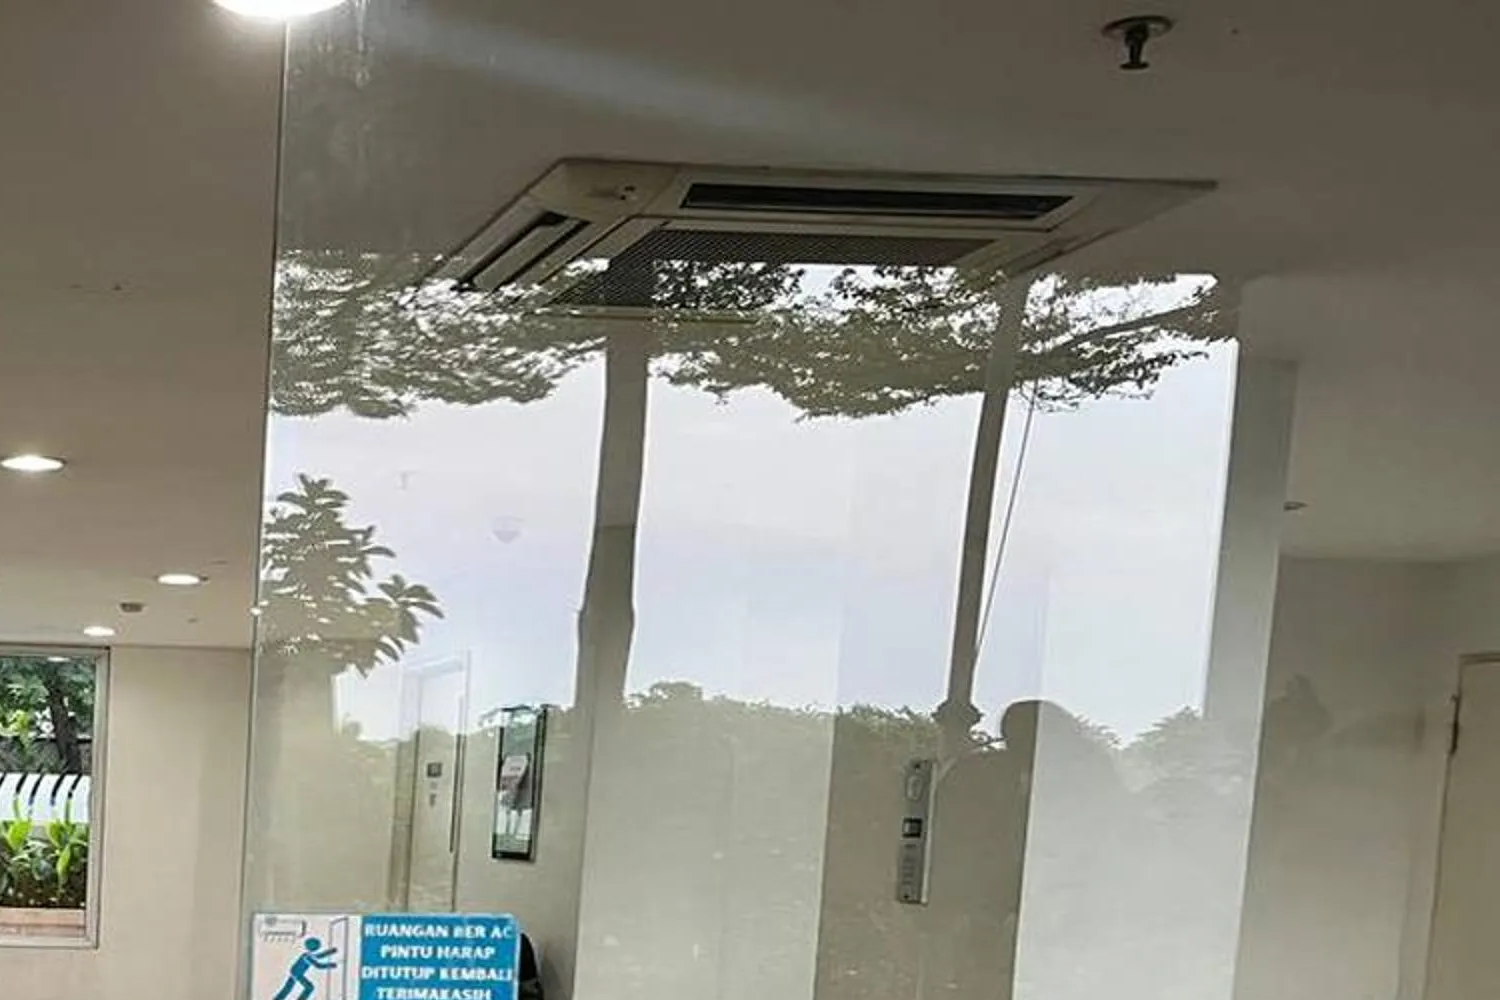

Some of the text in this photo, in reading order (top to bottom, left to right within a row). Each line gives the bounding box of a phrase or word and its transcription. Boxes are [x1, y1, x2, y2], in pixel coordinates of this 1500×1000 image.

[364, 923, 513, 939] RUANGAN BER AC
[380, 944, 496, 960] PINTU HARAP
[361, 965, 513, 981] DITUTUP KEMBALI
